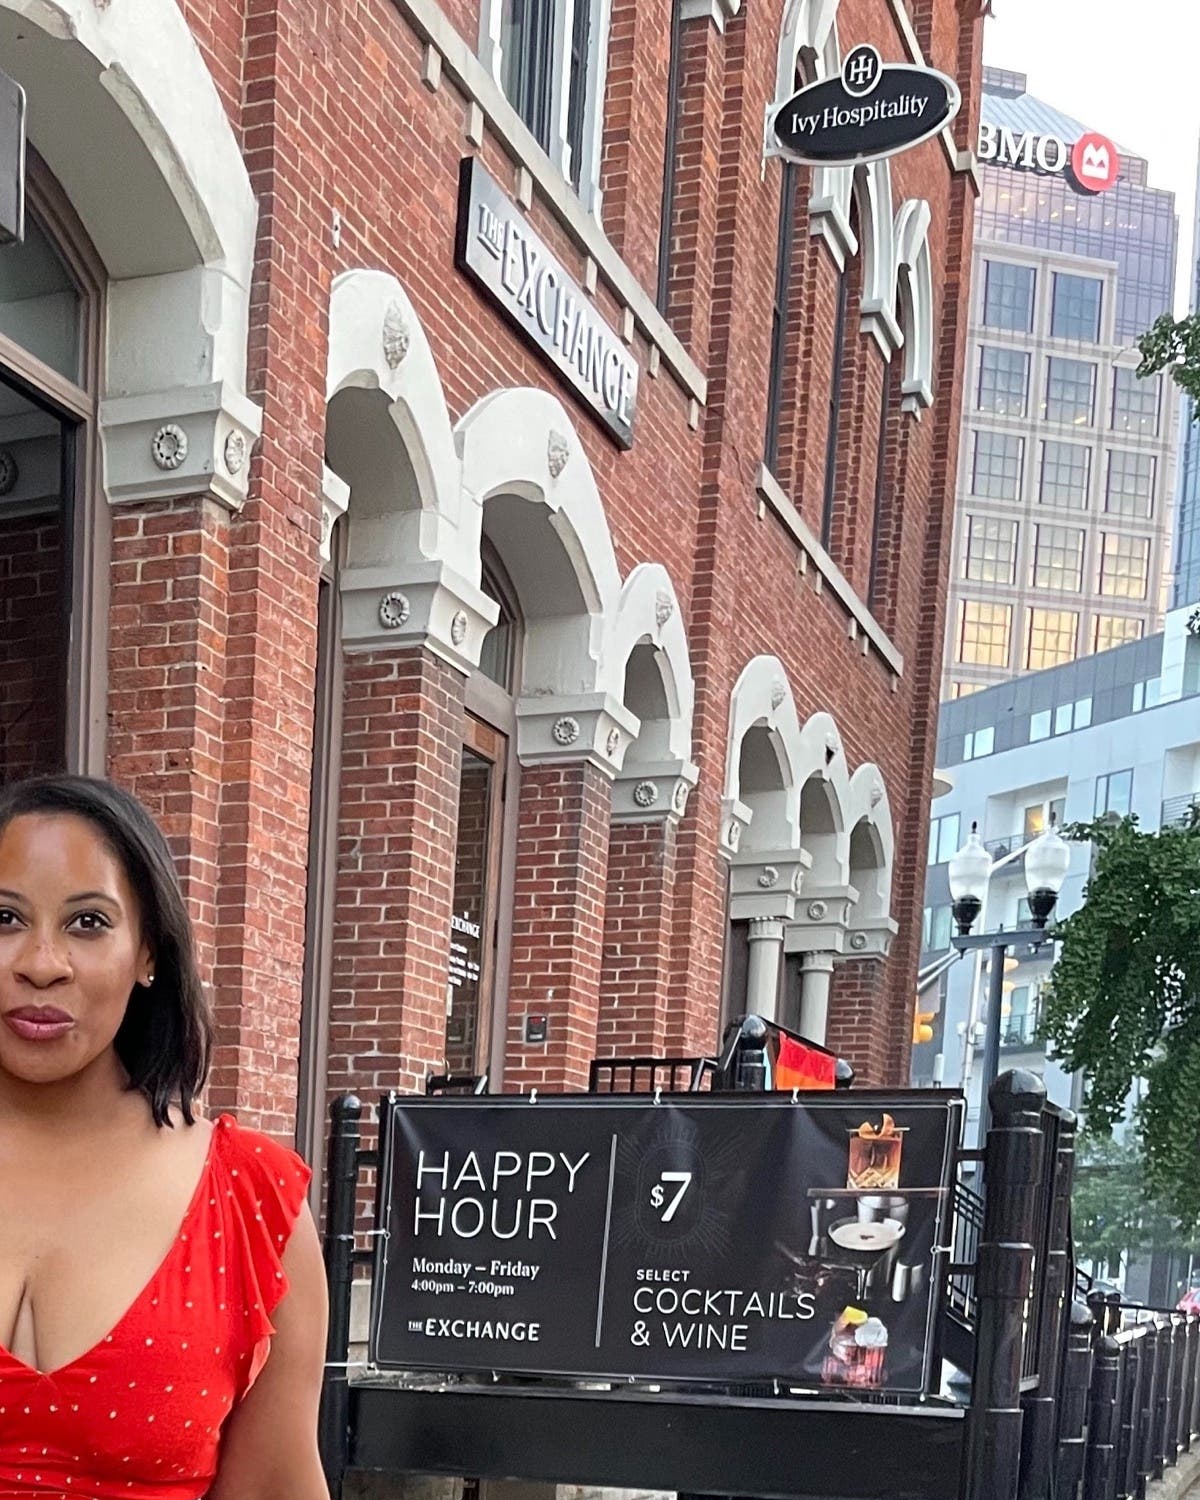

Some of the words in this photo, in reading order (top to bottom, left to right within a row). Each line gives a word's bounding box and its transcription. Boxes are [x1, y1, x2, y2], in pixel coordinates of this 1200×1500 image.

[791, 113, 821, 135] Ivy
[822, 95, 929, 128] Hospitality
[977, 121, 1067, 172] BMO
[478, 202, 504, 254] THE
[501, 219, 634, 428] EXCHANGE
[416, 1150, 591, 1193] HAPPY
[650, 1171, 692, 1222] $7
[414, 1196, 558, 1240] HOUR
[412, 1257, 472, 1279] Monday
[490, 1260, 540, 1281] Friday
[636, 1268, 691, 1283] SELECT
[411, 1278, 454, 1295] 4:00pm
[468, 1280, 515, 1298] 7:00pm
[633, 1286, 816, 1321] COCKTAILS
[408, 1320, 423, 1331] THE
[425, 1317, 540, 1342] EXCHANGE
[630, 1319, 650, 1347] &
[661, 1321, 749, 1351] WINE
